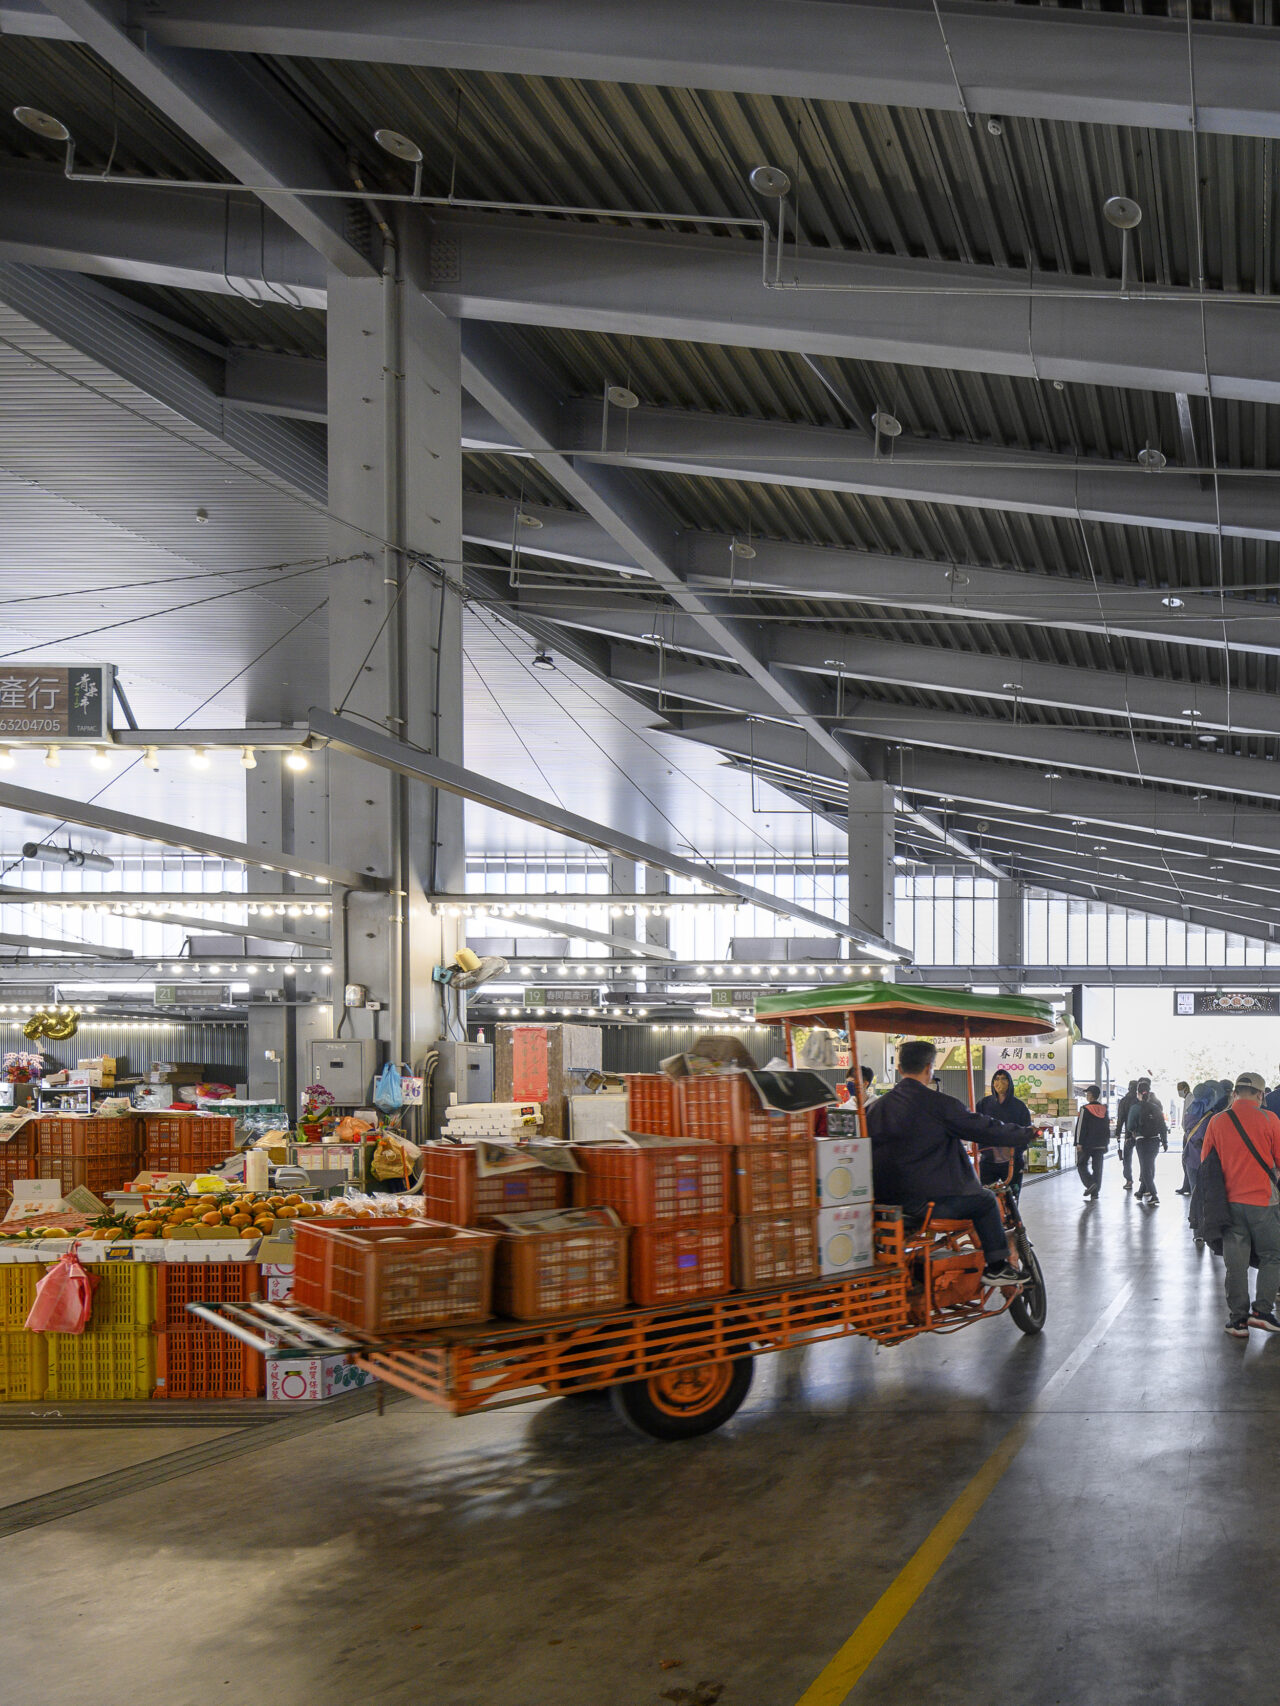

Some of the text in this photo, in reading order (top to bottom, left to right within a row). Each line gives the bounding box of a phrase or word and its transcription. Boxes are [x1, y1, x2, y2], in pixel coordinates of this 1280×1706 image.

[159, 988, 171, 998] 21
[529, 991, 541, 1001] 19
[715, 992, 727, 1002] 18
[309, 1361, 318, 1399] 品質保證
